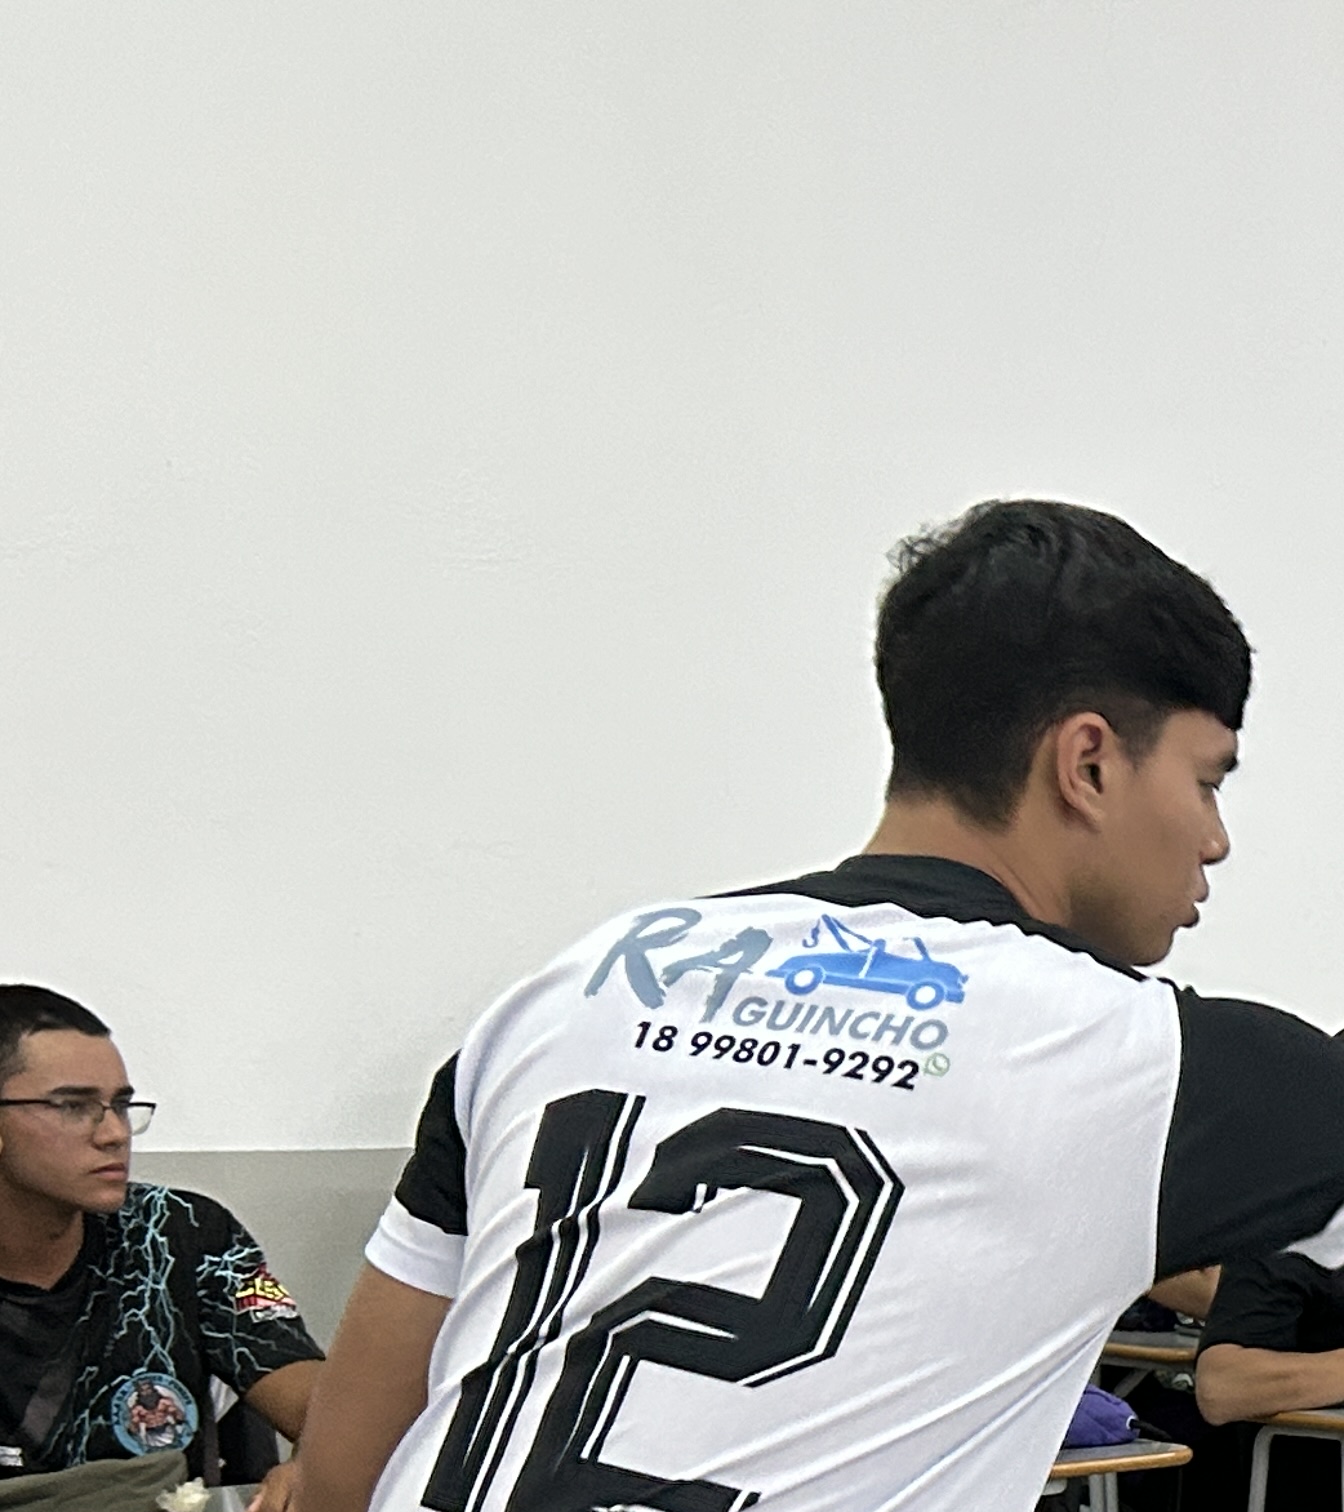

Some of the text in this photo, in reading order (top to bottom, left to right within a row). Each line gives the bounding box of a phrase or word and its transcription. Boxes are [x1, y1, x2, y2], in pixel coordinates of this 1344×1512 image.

[583, 907, 773, 1023] RA
[633, 1020, 920, 1090] 18 99801-9292
[732, 996, 949, 1053] GUINCHO
